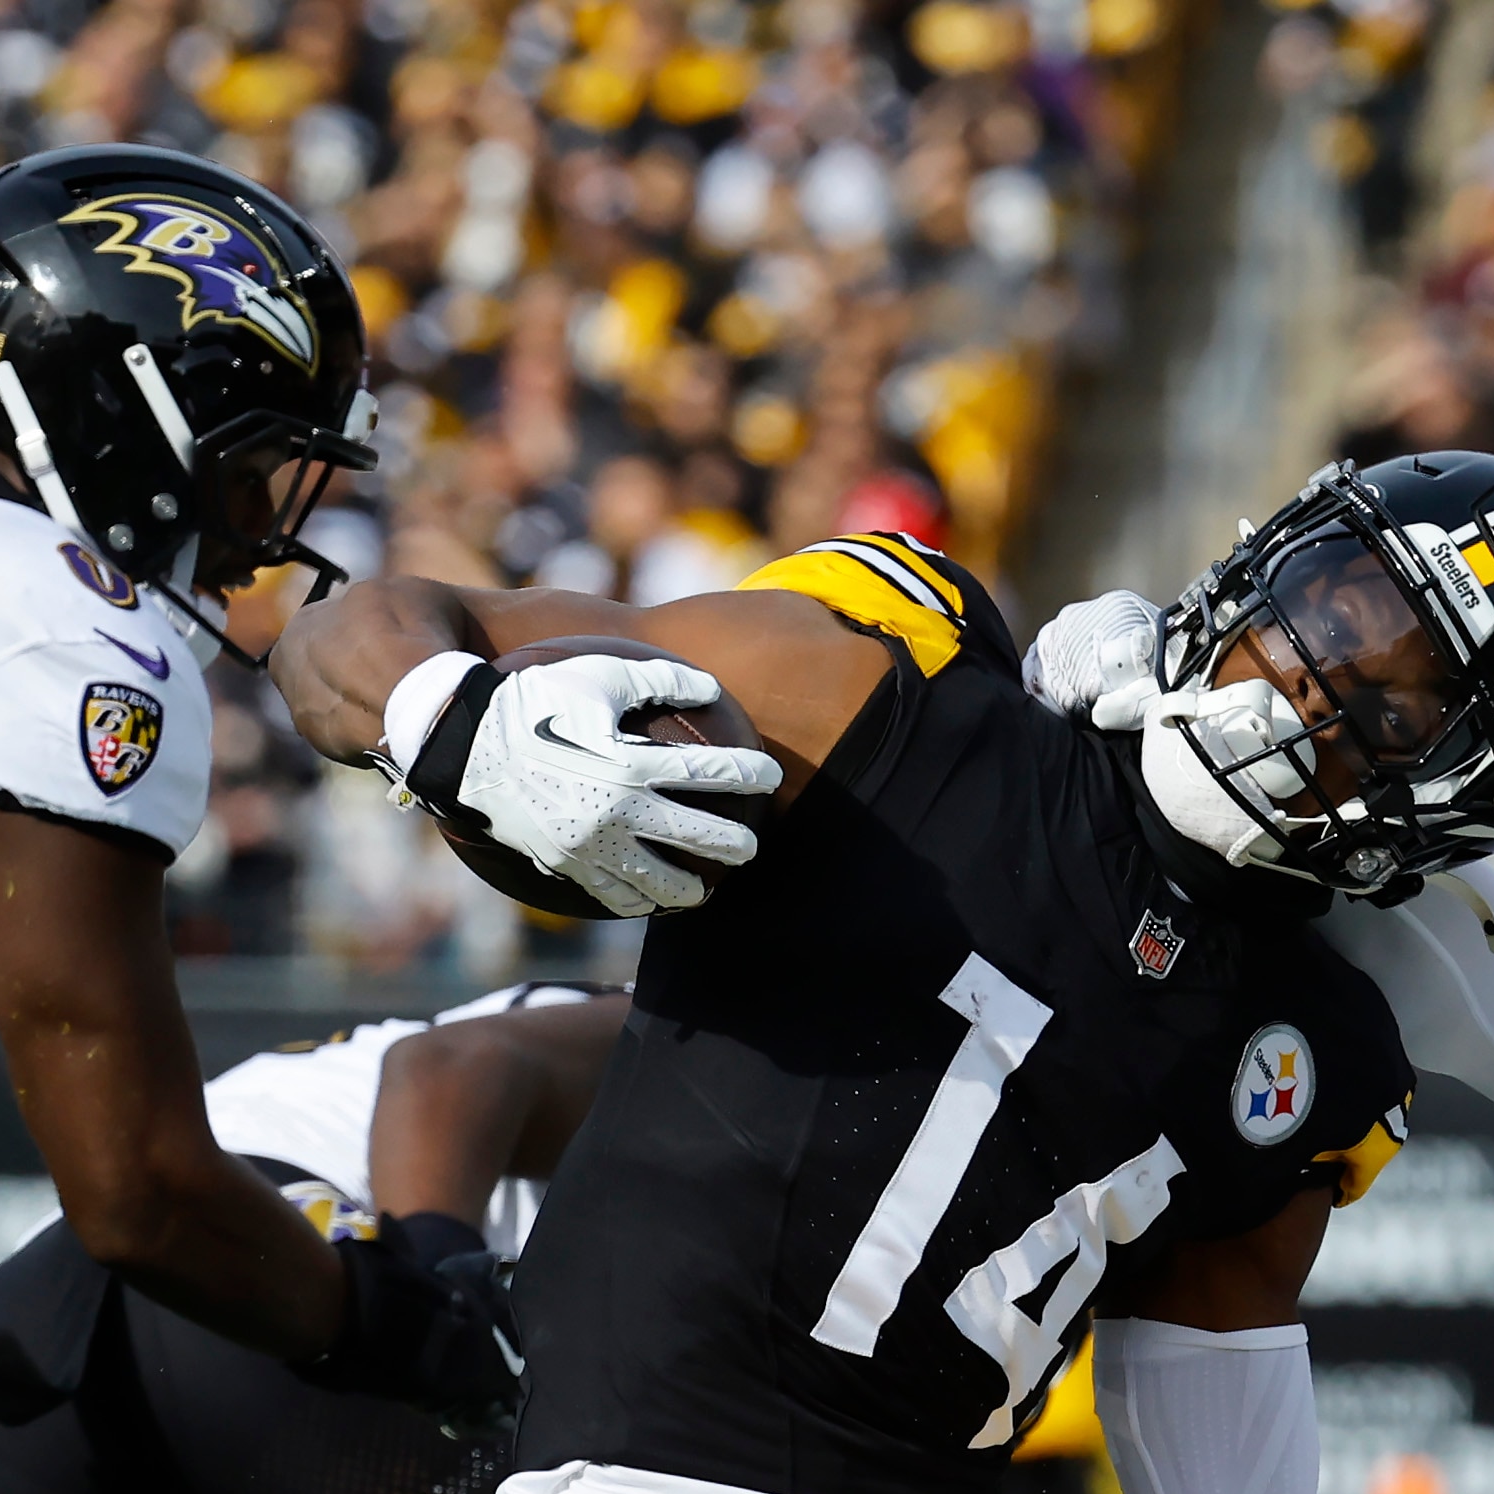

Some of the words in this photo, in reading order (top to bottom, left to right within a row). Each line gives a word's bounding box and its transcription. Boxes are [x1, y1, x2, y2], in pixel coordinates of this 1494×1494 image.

[57, 541, 140, 611] 0
[1430, 542, 1480, 610] Steelers
[92, 685, 159, 717] RAVENS
[1137, 935, 1168, 972] NFL
[1254, 1047, 1276, 1086] Steelers
[810, 951, 1187, 1449] 14
